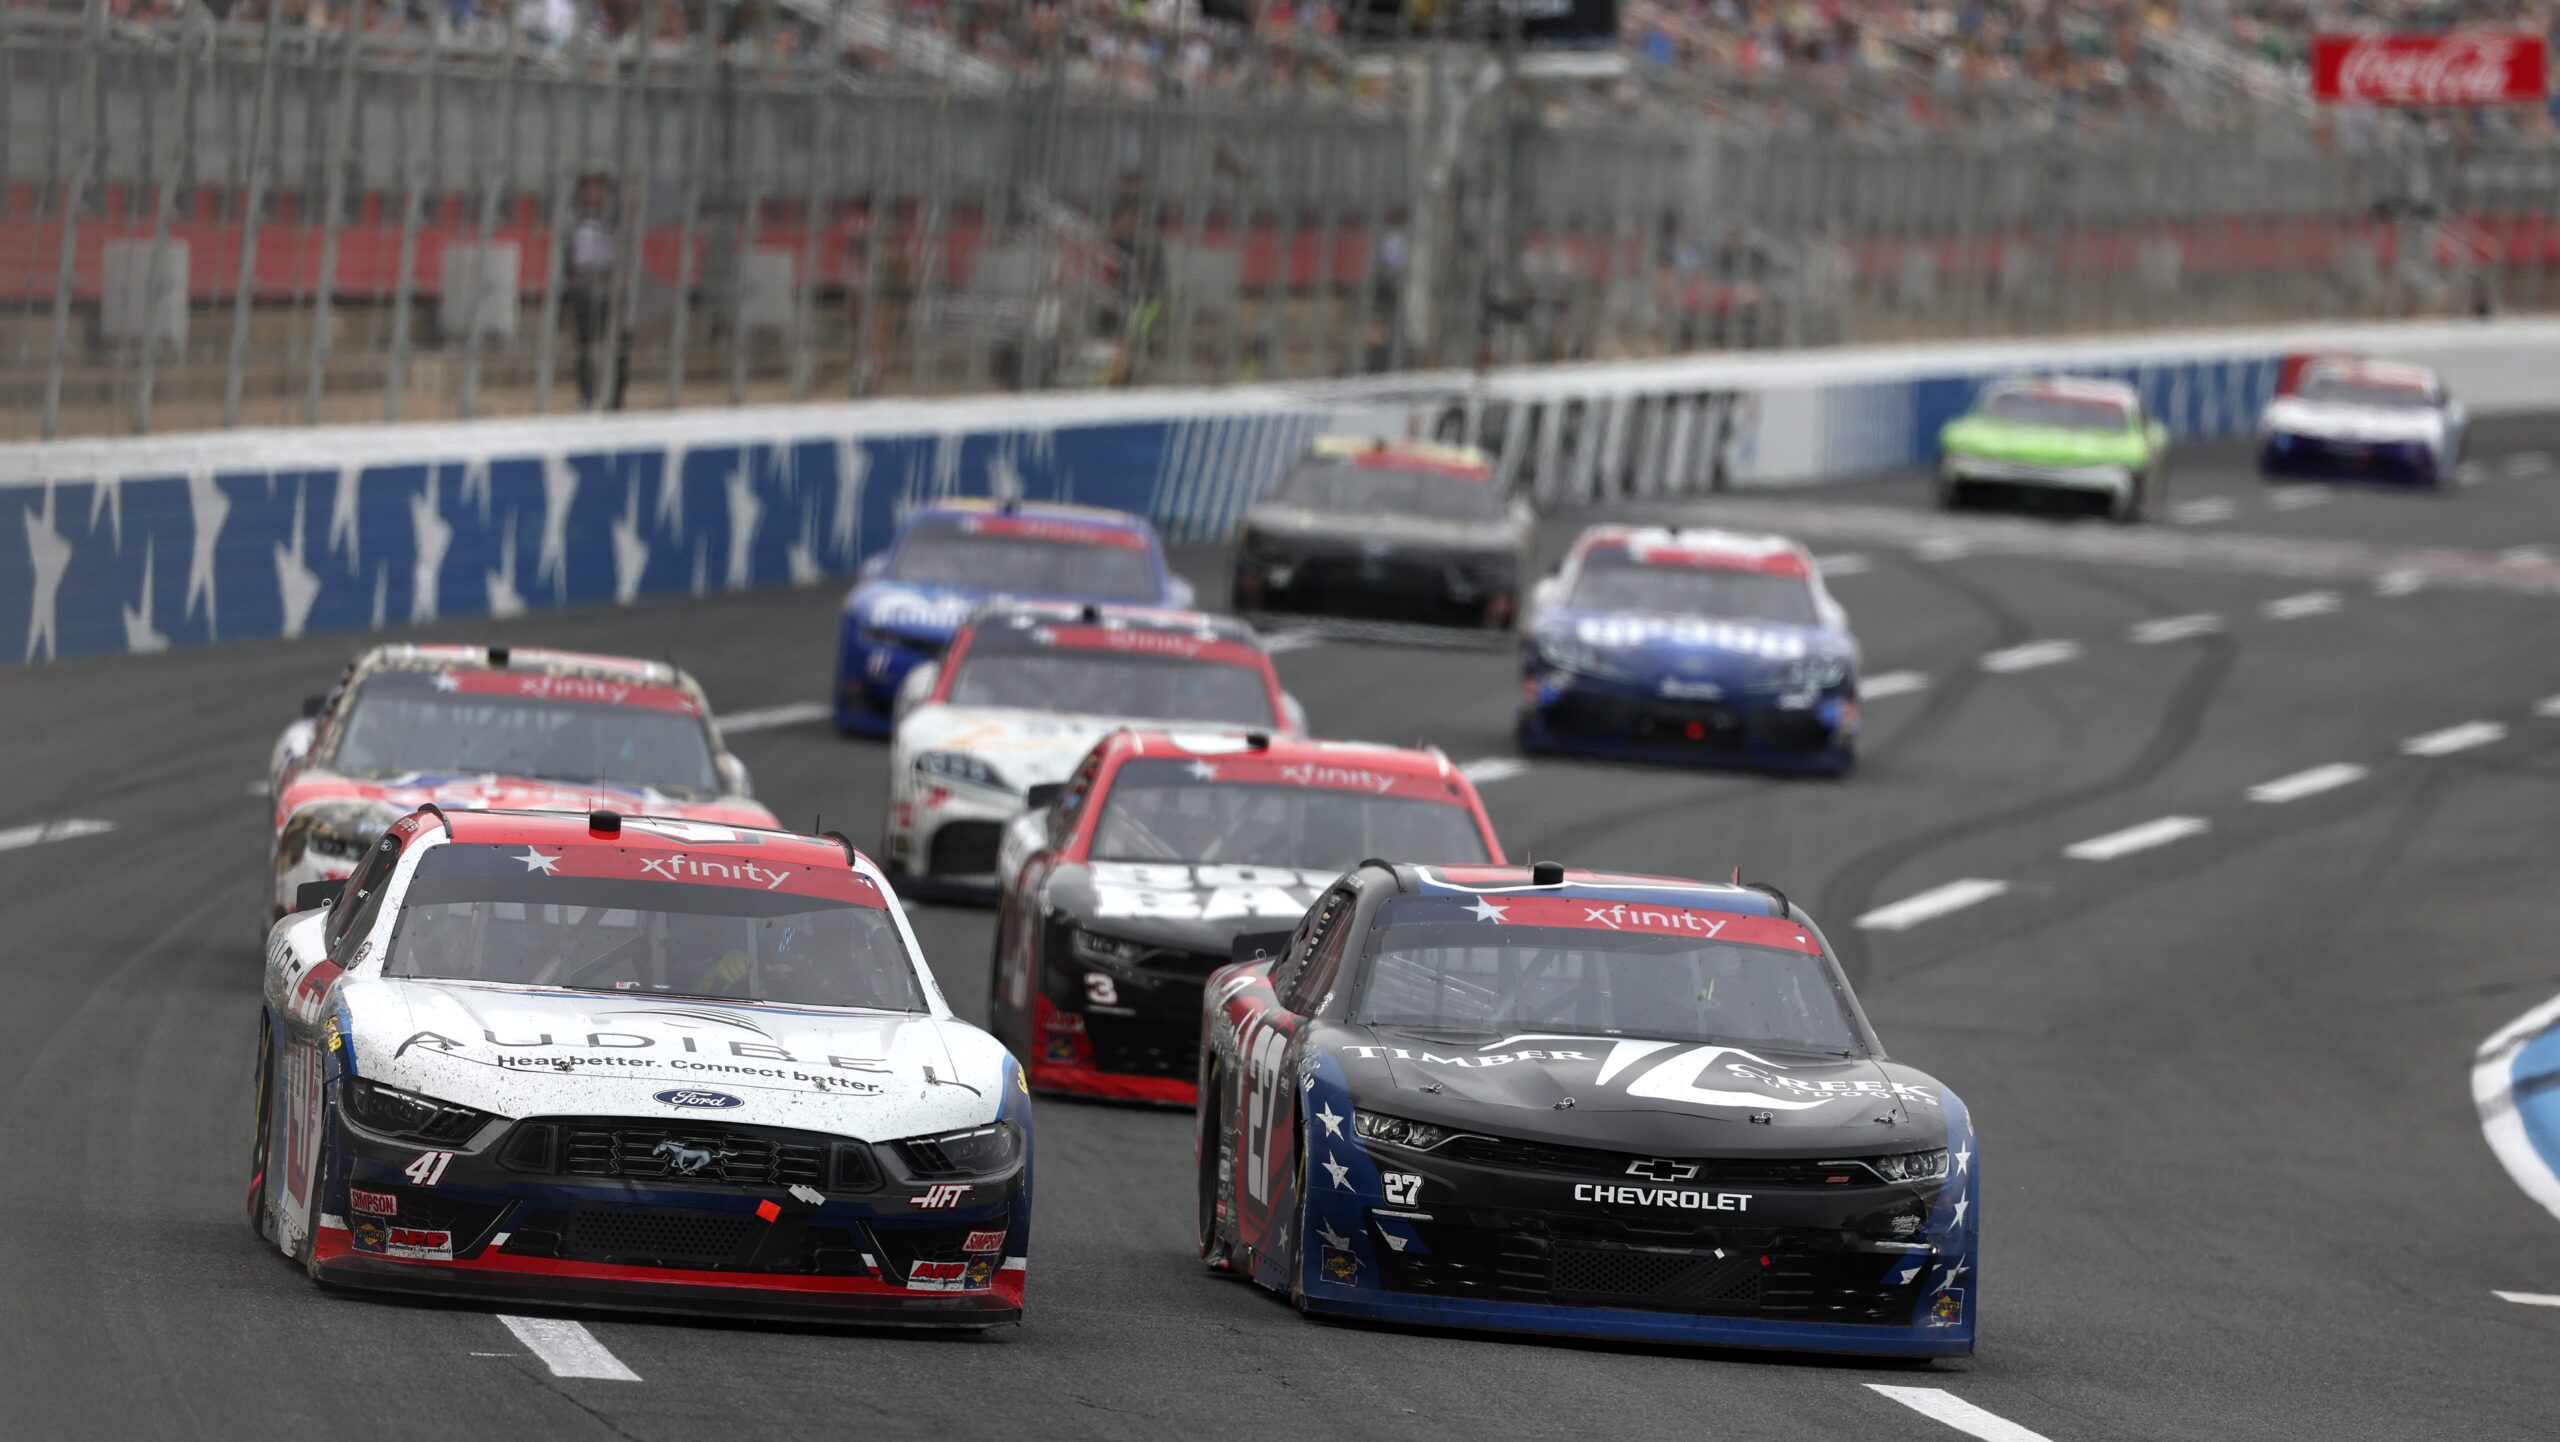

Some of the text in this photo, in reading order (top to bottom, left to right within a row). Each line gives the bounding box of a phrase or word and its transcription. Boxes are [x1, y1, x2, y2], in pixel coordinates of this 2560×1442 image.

[1282, 762, 1396, 794] xfinity
[639, 854, 791, 890] xfinity
[1583, 904, 1728, 938] xfinity
[1083, 972, 1118, 1005] 3
[393, 1030, 983, 1098] AUDIBEL
[1342, 1045, 1599, 1068] TIMBER
[497, 1054, 886, 1095] Hear better. Connect better.
[1725, 1062, 1939, 1099] CREEK
[671, 1089, 728, 1109] Ford
[404, 1151, 456, 1187] 41
[351, 1190, 396, 1216] SIMPSON
[909, 1184, 975, 1209] HFT
[1383, 1172, 1423, 1206] 27
[1574, 1184, 1753, 1212] CHEVROLET
[389, 1228, 449, 1247] ARP
[911, 1263, 967, 1279] ARP
